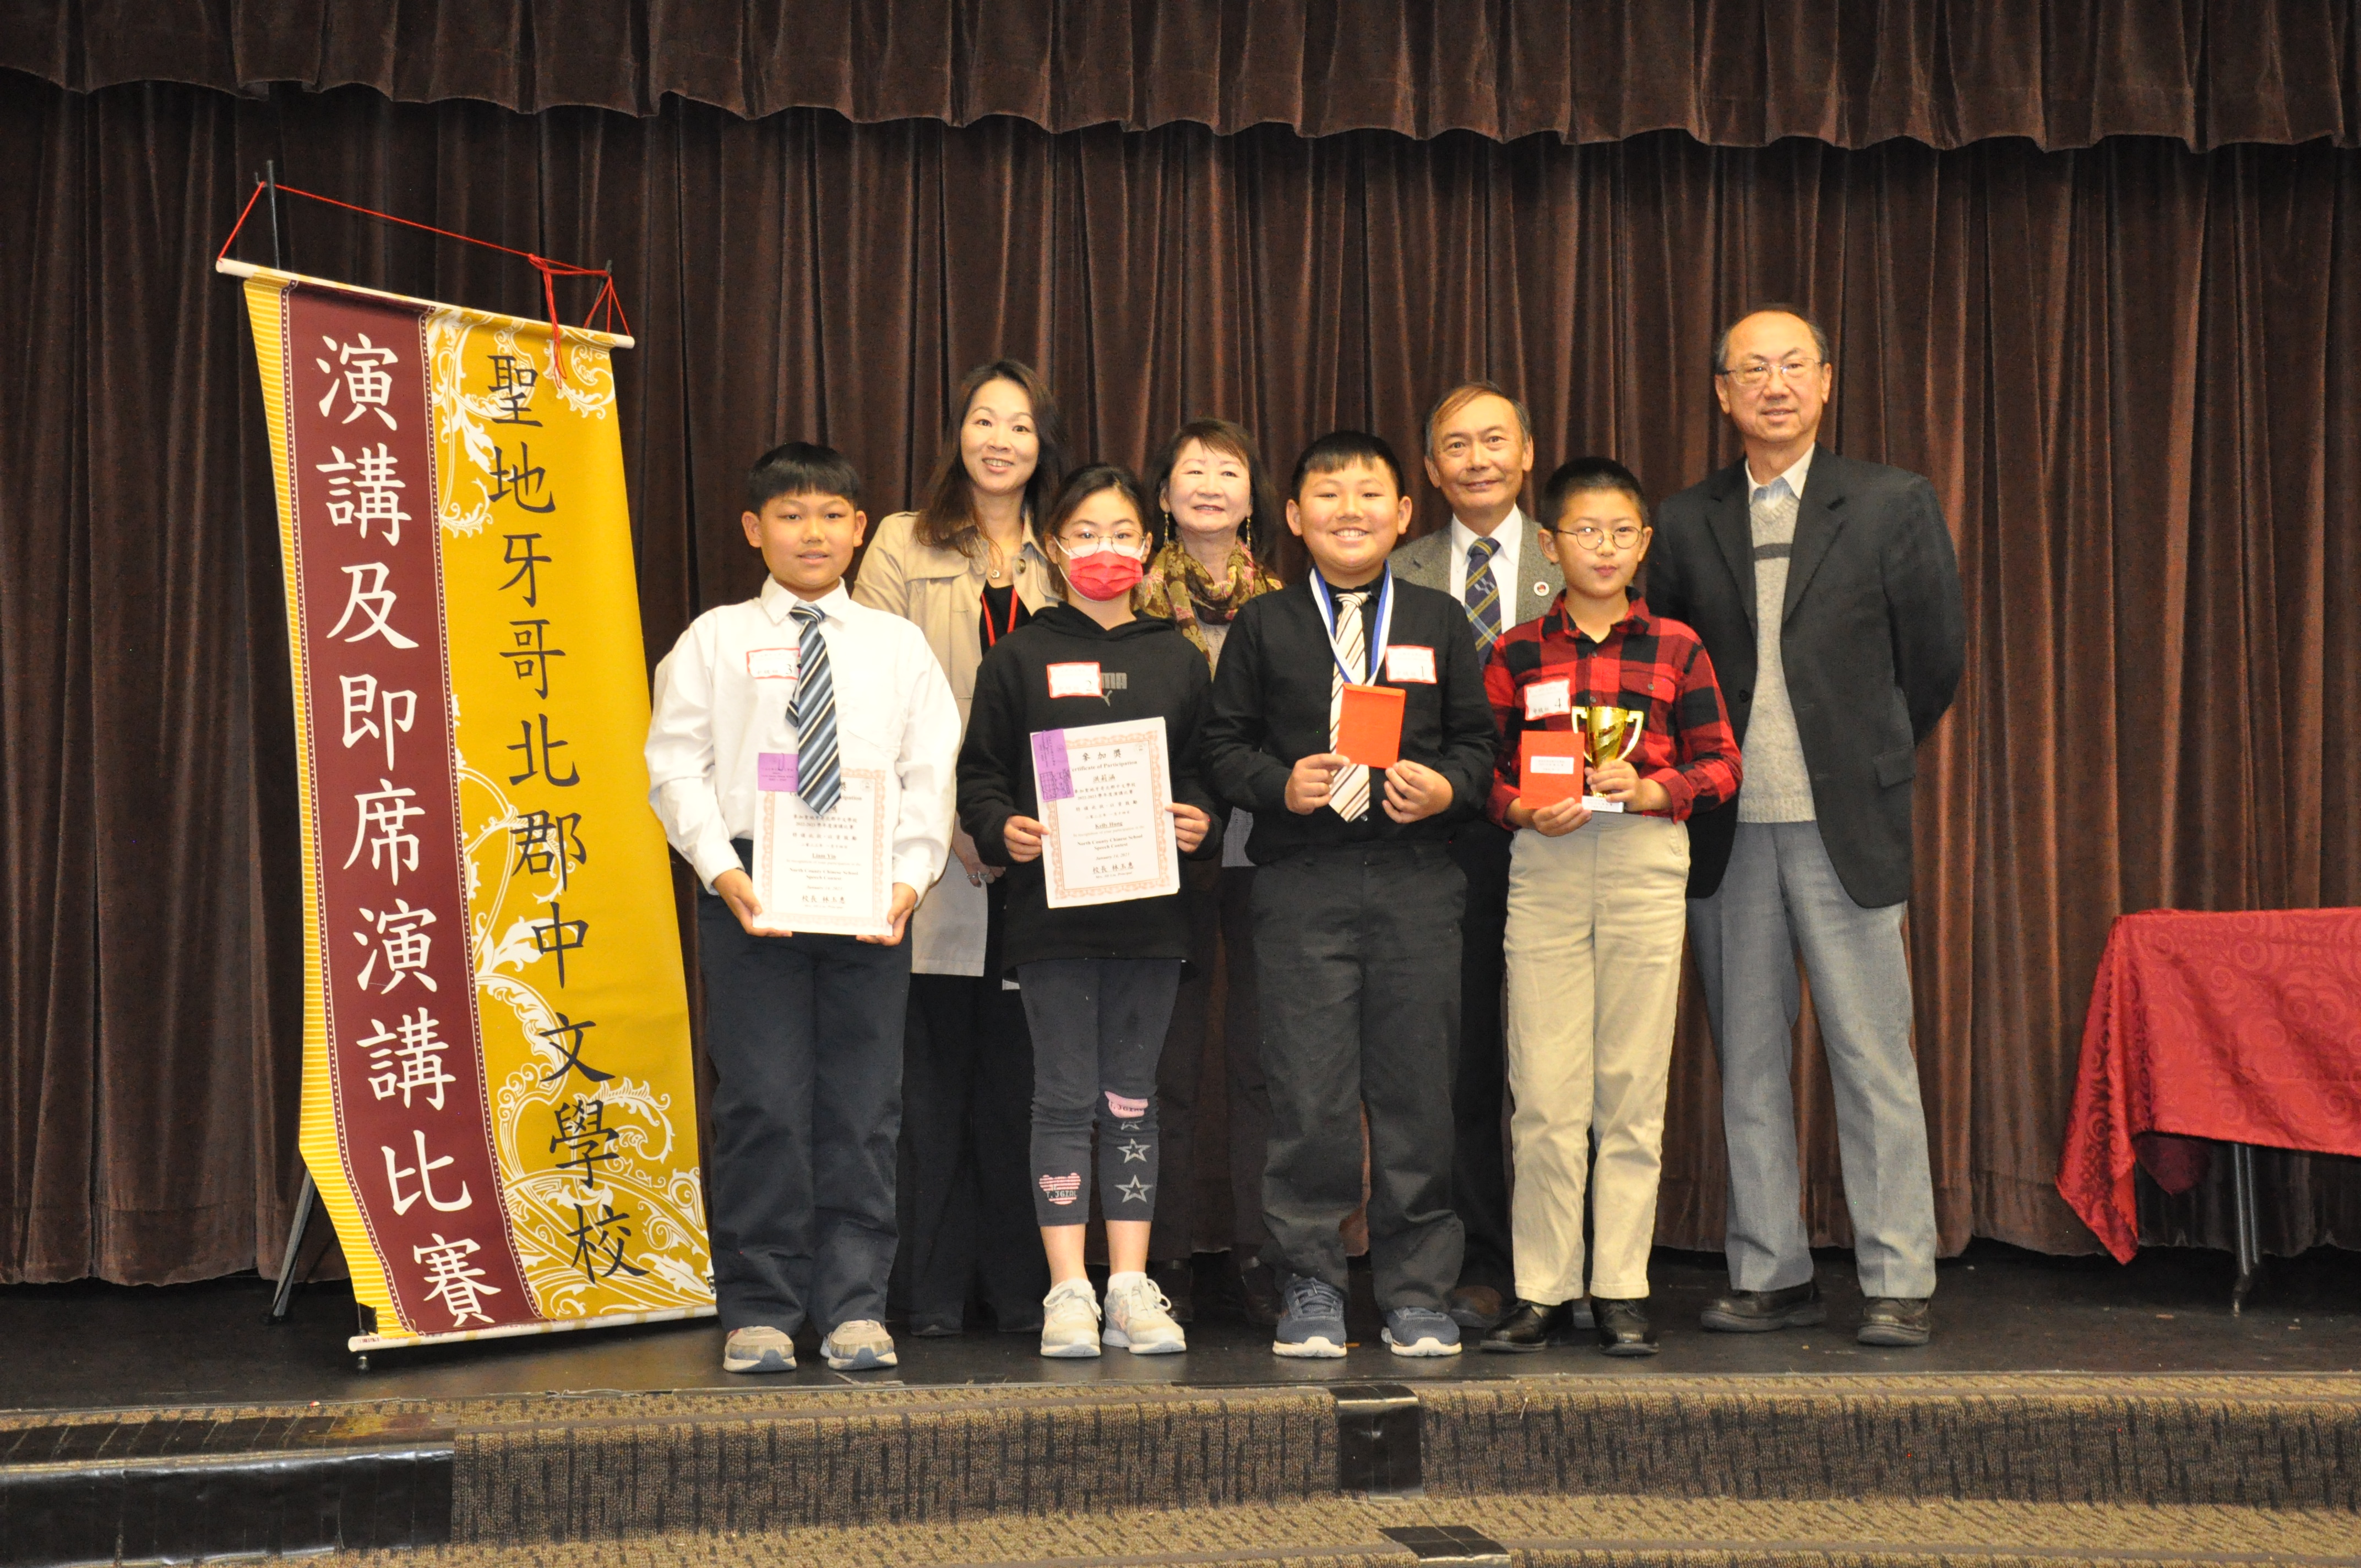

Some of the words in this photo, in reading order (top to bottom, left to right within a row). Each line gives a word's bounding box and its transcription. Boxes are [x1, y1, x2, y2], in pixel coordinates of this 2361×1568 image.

[786, 663, 793, 675] 3
[1086, 679, 1092, 691] 2
[1102, 672, 1128, 689] MA
[1554, 698, 1562, 709] 4
[488, 352, 651, 1286] 聖地牙哥北郡中文學校
[314, 332, 503, 1329] 演講及即席演講比賽
